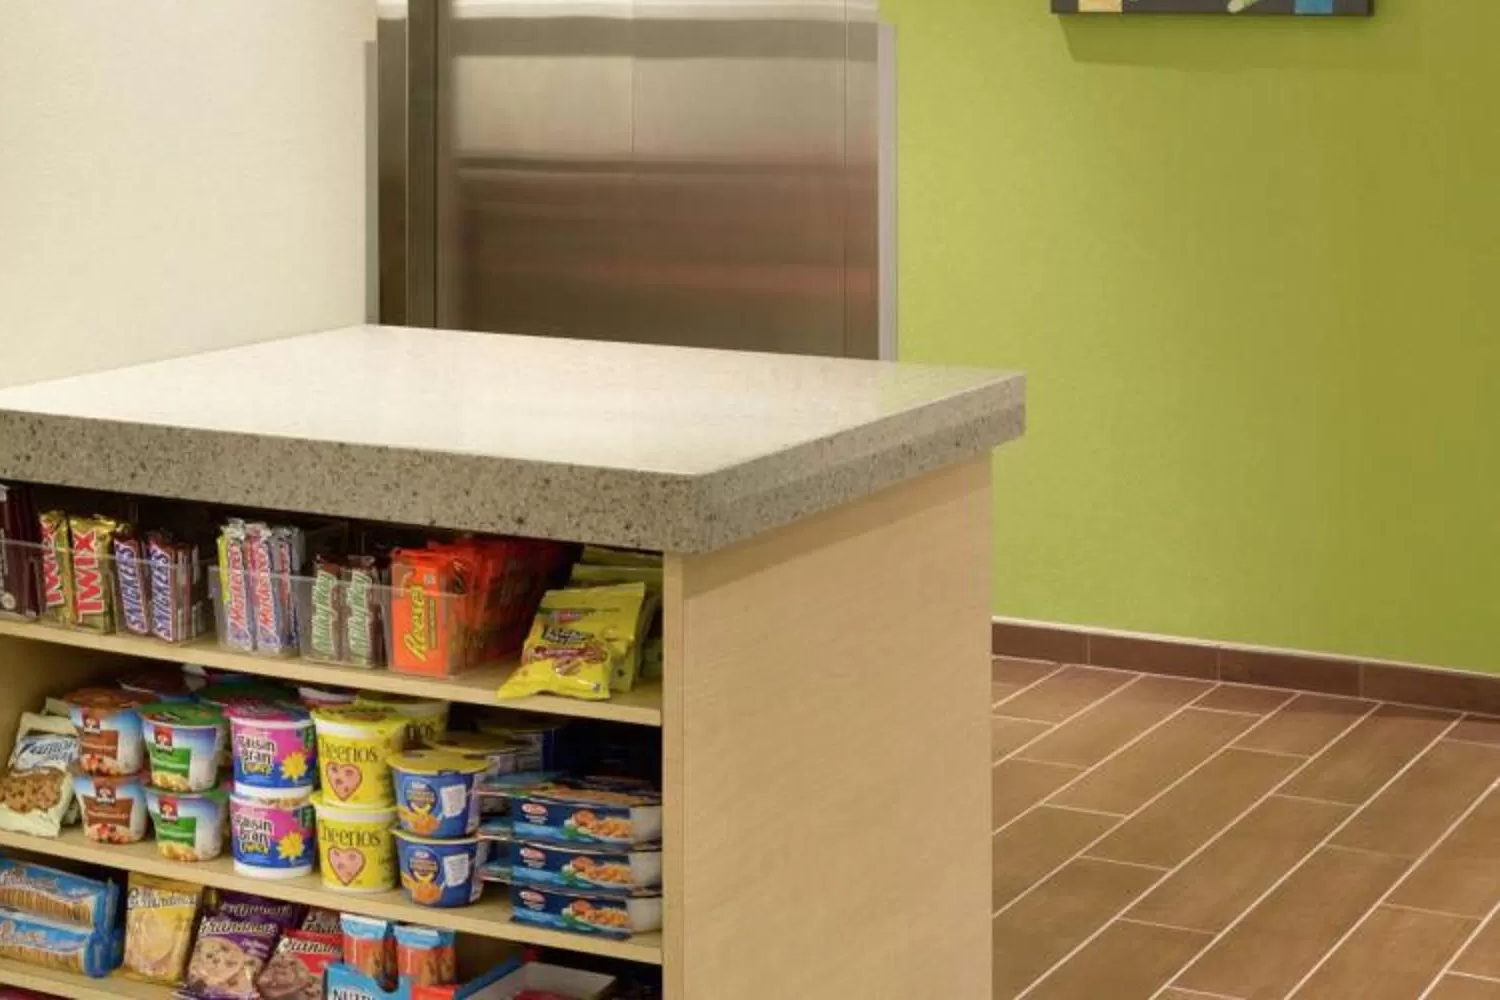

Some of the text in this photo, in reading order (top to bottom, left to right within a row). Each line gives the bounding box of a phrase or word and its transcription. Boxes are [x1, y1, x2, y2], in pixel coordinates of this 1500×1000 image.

[74, 529, 105, 615] TWIX
[114, 541, 147, 633] SNICKERS
[150, 547, 172, 641] SNICKERS
